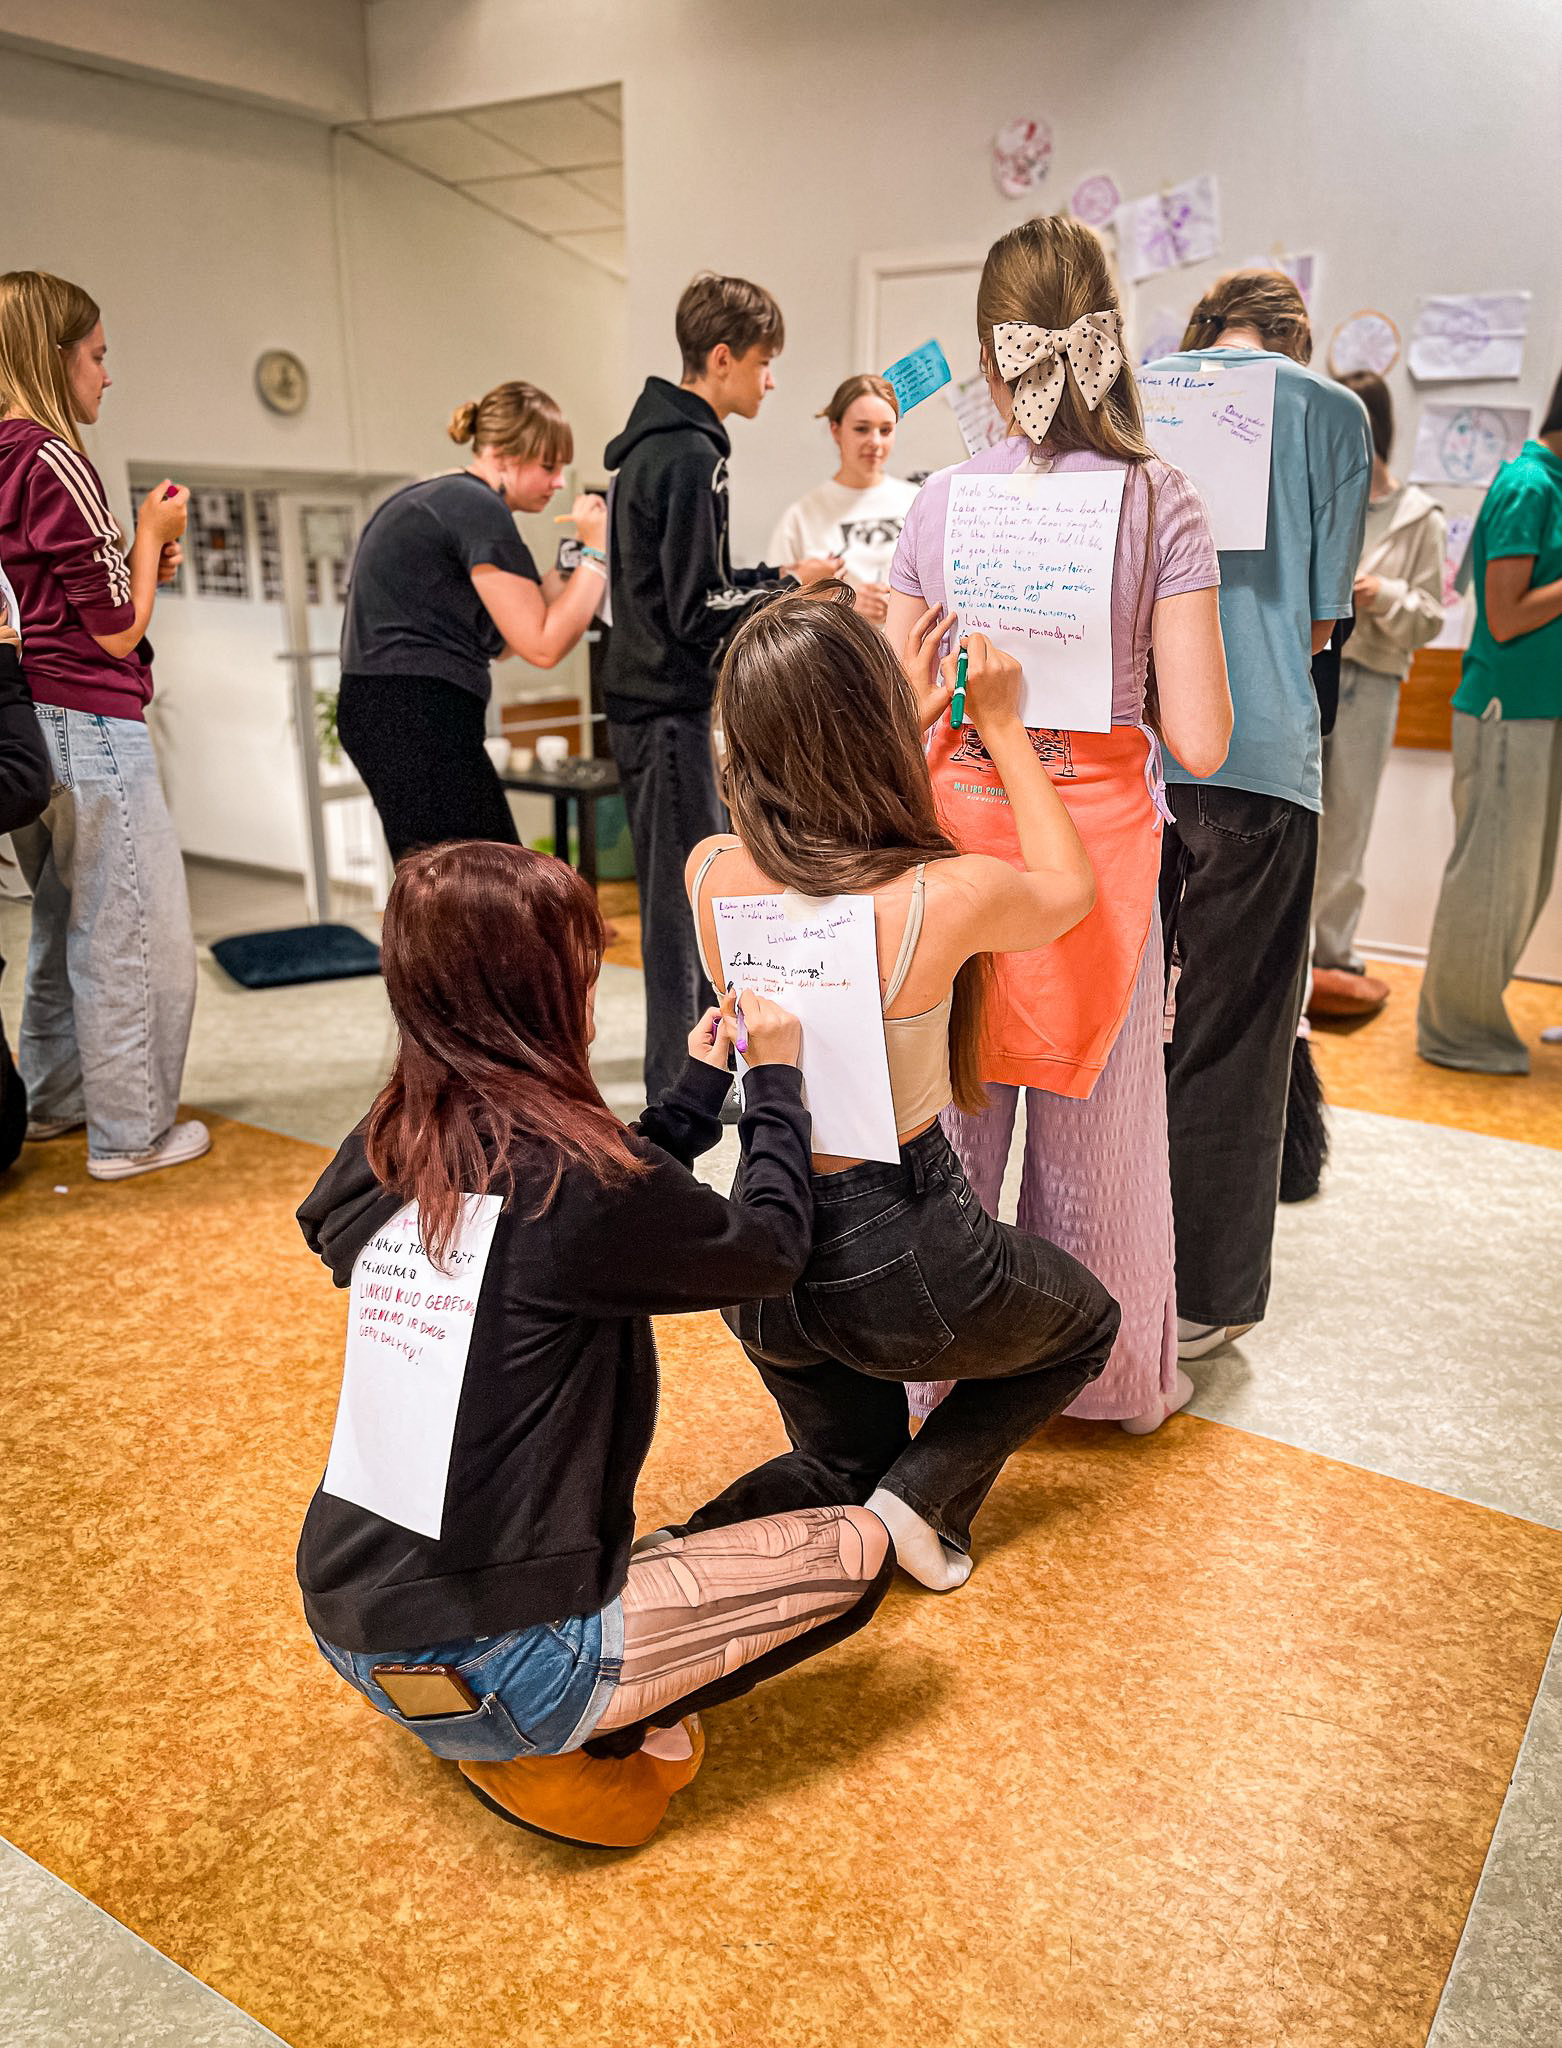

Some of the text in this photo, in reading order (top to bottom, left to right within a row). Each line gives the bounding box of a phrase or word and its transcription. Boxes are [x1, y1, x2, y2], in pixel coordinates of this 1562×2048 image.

[766, 958, 787, 977] daug
[360, 1283, 392, 1301] LINKIU
[396, 1287, 421, 1307] KUO
[407, 1317, 418, 1330] IR
[420, 1322, 446, 1340] DAUG
